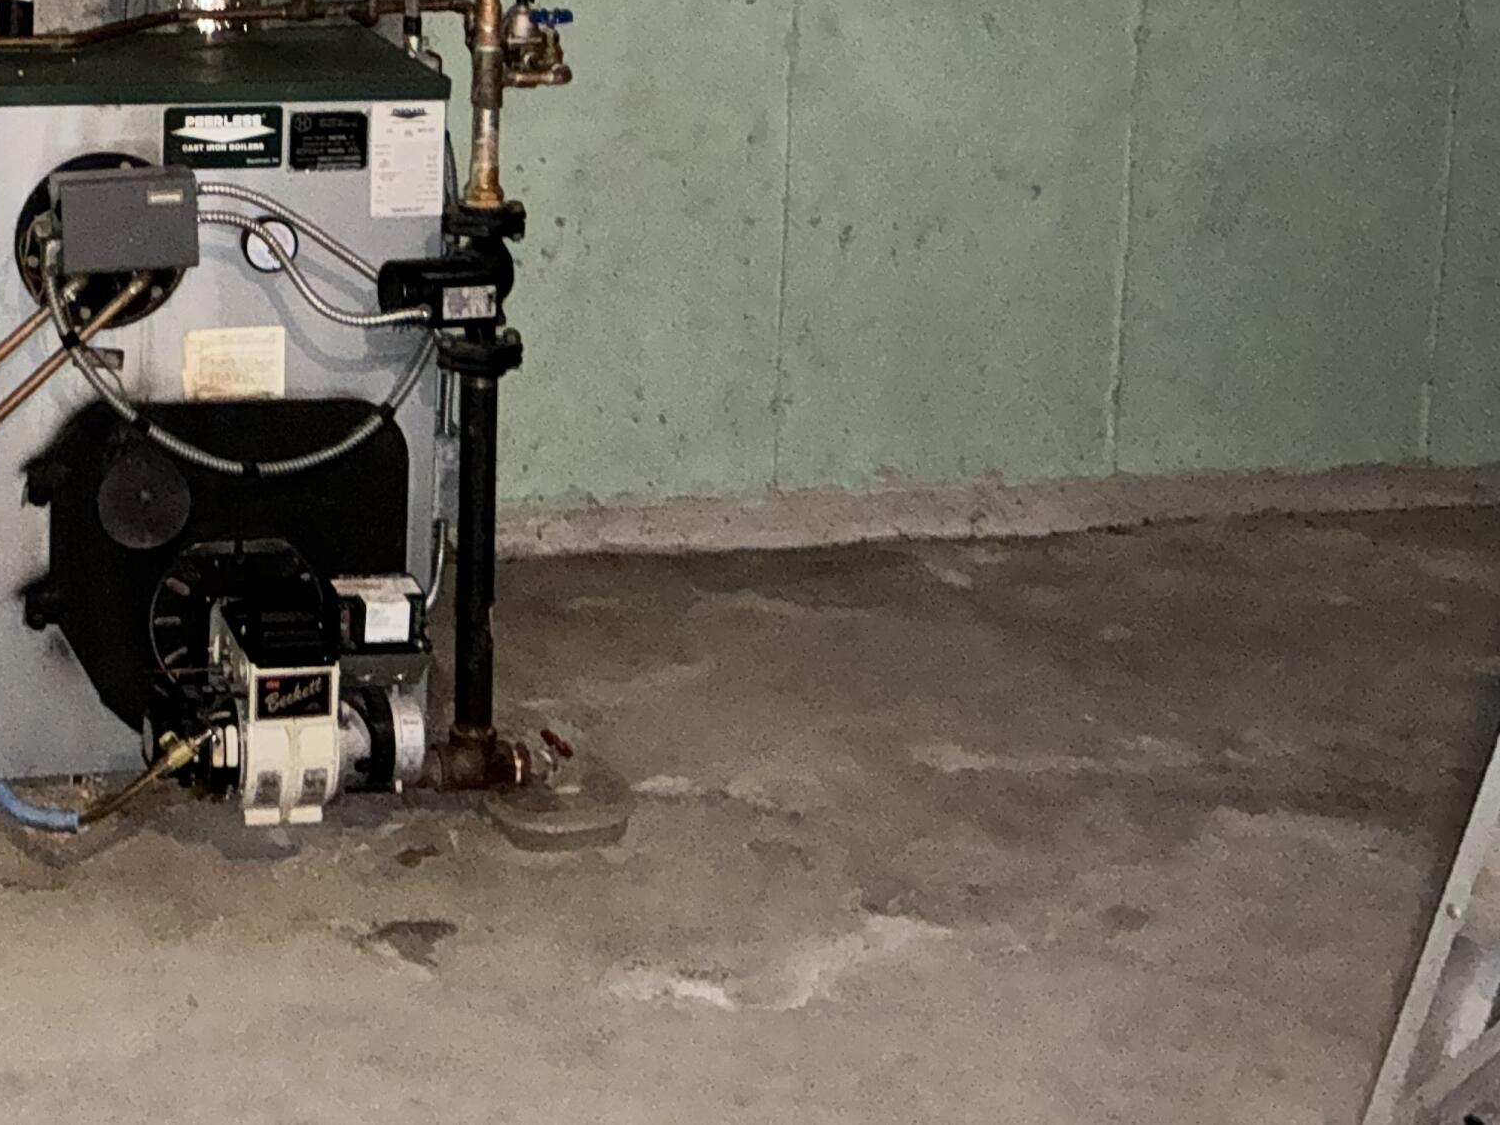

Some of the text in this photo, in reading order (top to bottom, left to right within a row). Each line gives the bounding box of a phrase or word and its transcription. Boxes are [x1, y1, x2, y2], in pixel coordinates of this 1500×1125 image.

[184, 114, 262, 128] PEERLESS
[181, 141, 265, 153] CAST IRON BOILERS
[264, 676, 323, 713] Beckett
